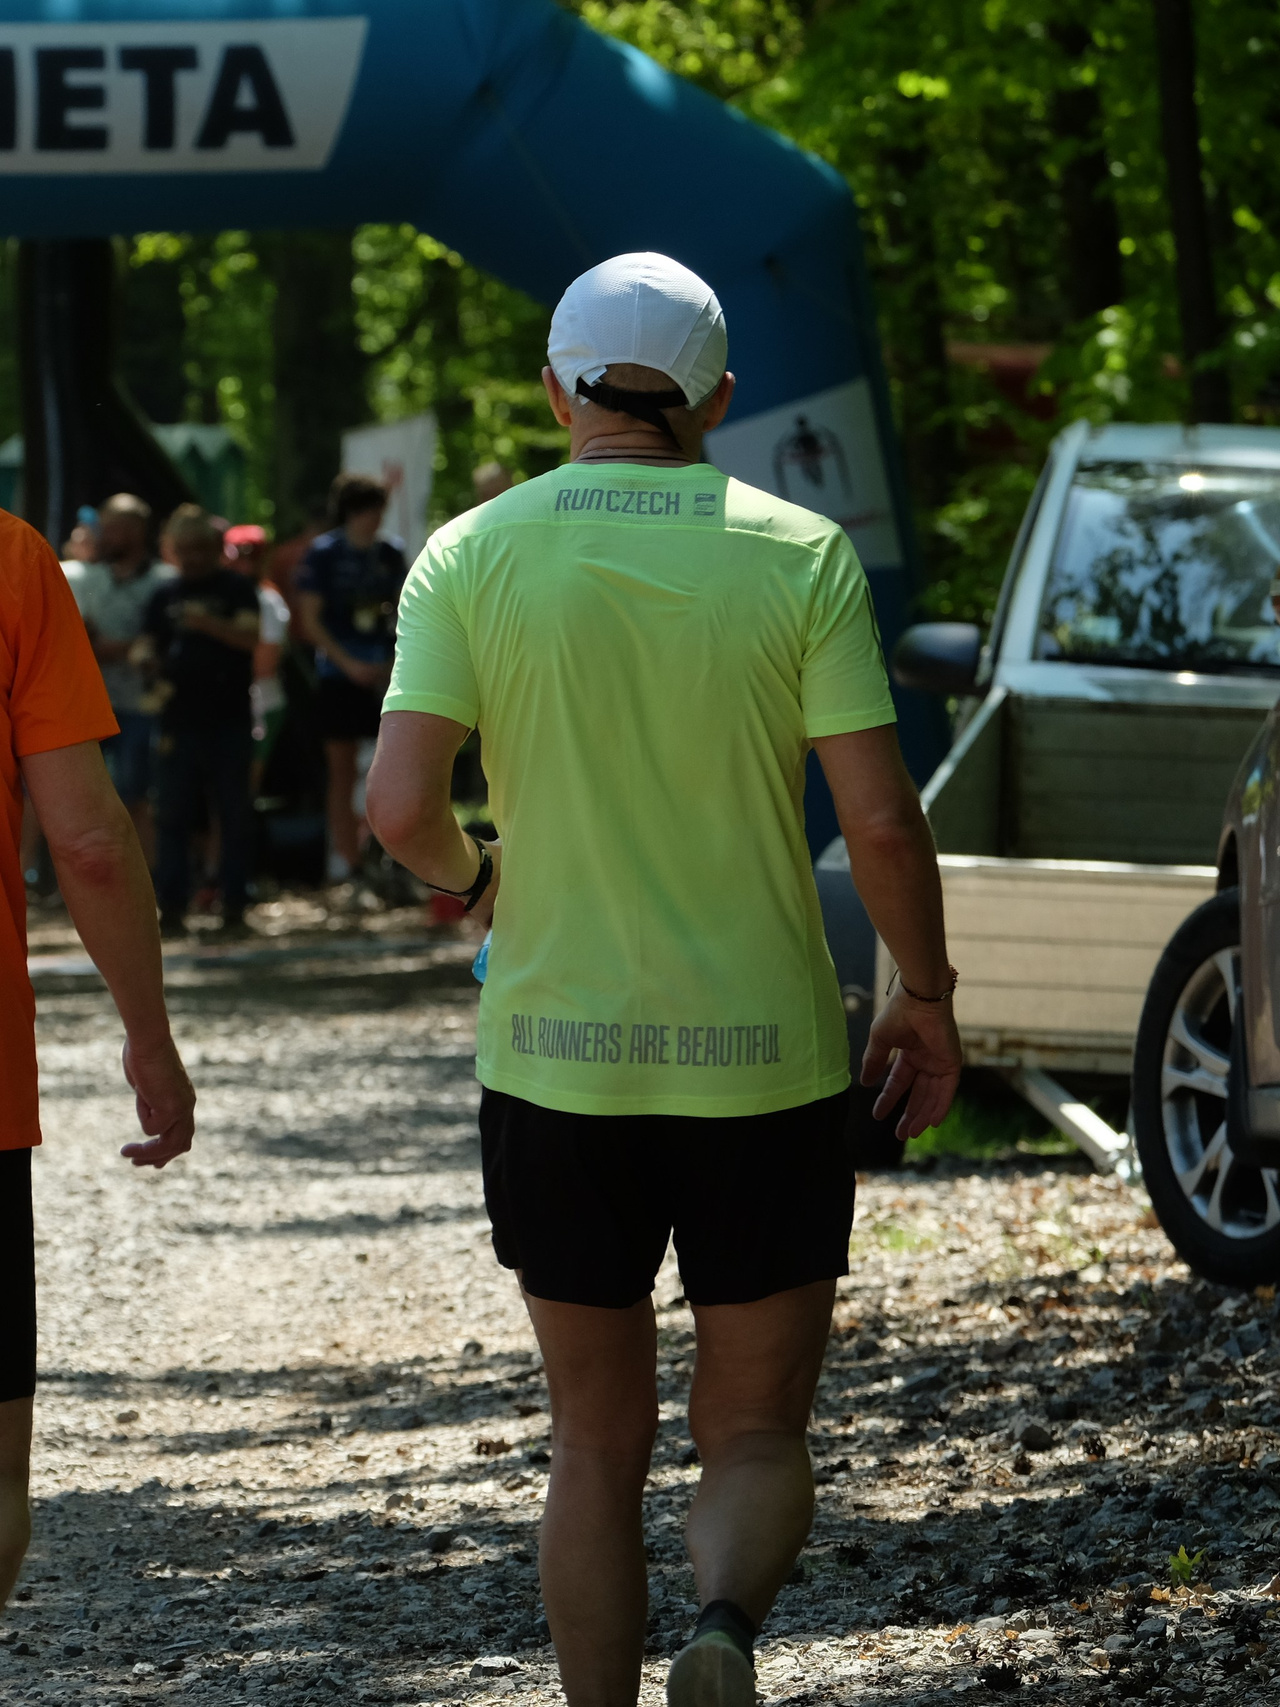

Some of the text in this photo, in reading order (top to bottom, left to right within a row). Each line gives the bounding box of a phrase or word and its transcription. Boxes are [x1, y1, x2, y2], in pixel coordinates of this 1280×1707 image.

[511, 1013, 781, 1067] ALL RUNNERS ARE BEAUTIFUL
